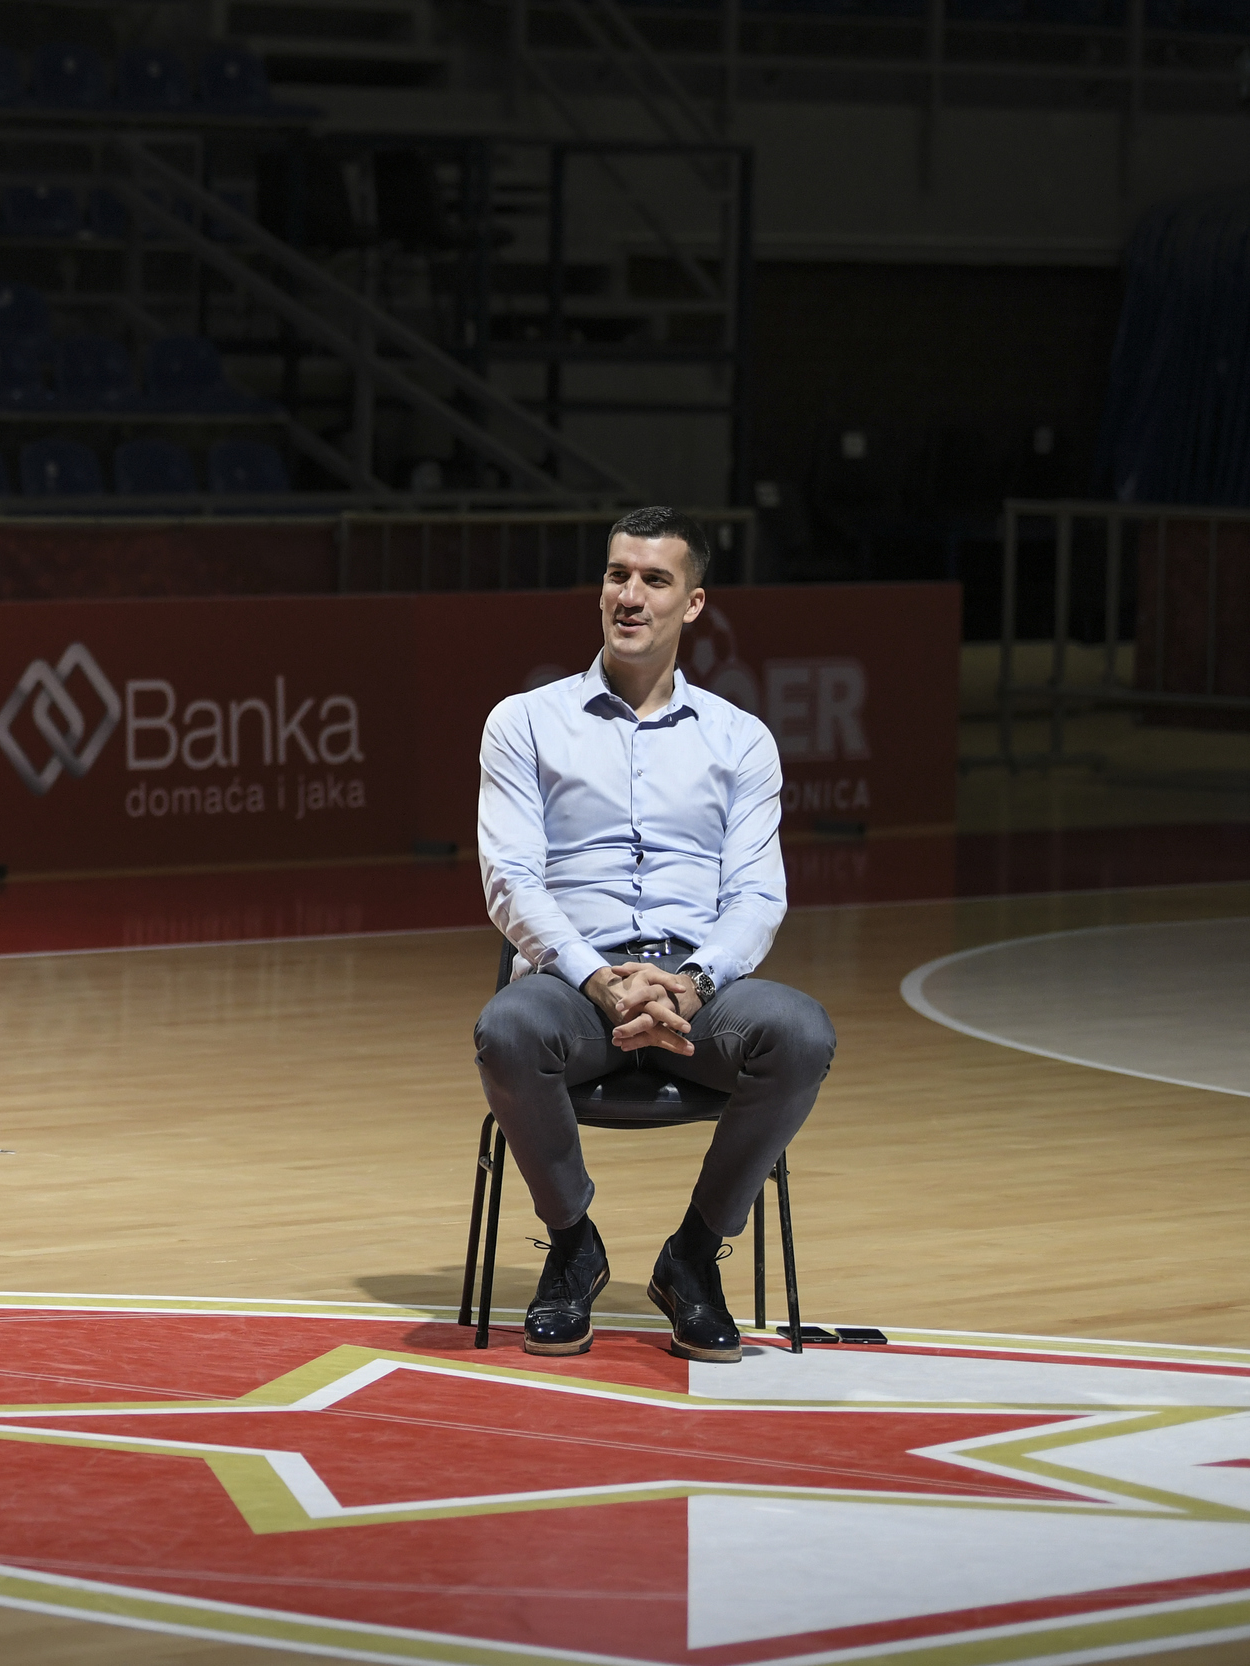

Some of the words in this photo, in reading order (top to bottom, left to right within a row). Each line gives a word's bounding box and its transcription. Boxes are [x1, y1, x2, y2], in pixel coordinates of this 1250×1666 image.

[125, 675, 366, 771] Banka
[125, 781, 265, 817] domaća
[295, 774, 366, 820] jaka
[782, 777, 870, 812] ONICA
